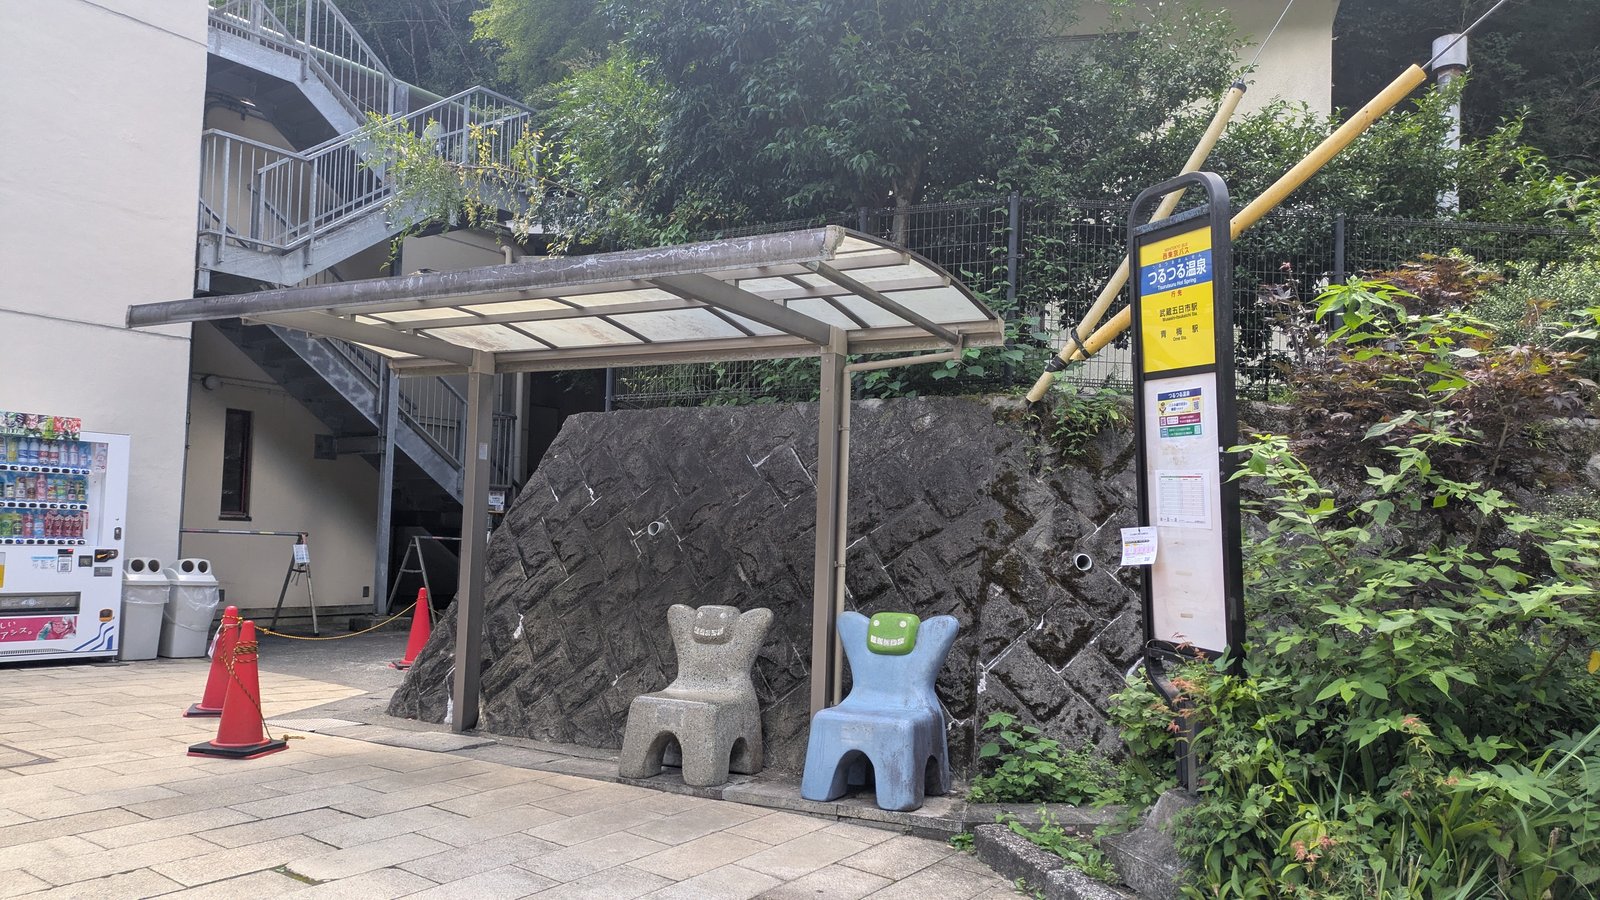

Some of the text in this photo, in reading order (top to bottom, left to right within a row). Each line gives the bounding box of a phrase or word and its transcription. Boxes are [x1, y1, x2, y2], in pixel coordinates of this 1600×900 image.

[1162, 247, 1190, 260] 西東京バス
[1148, 258, 1206, 285] つるつる温泉
[1159, 302, 1198, 318] 武蔵五日市駅
